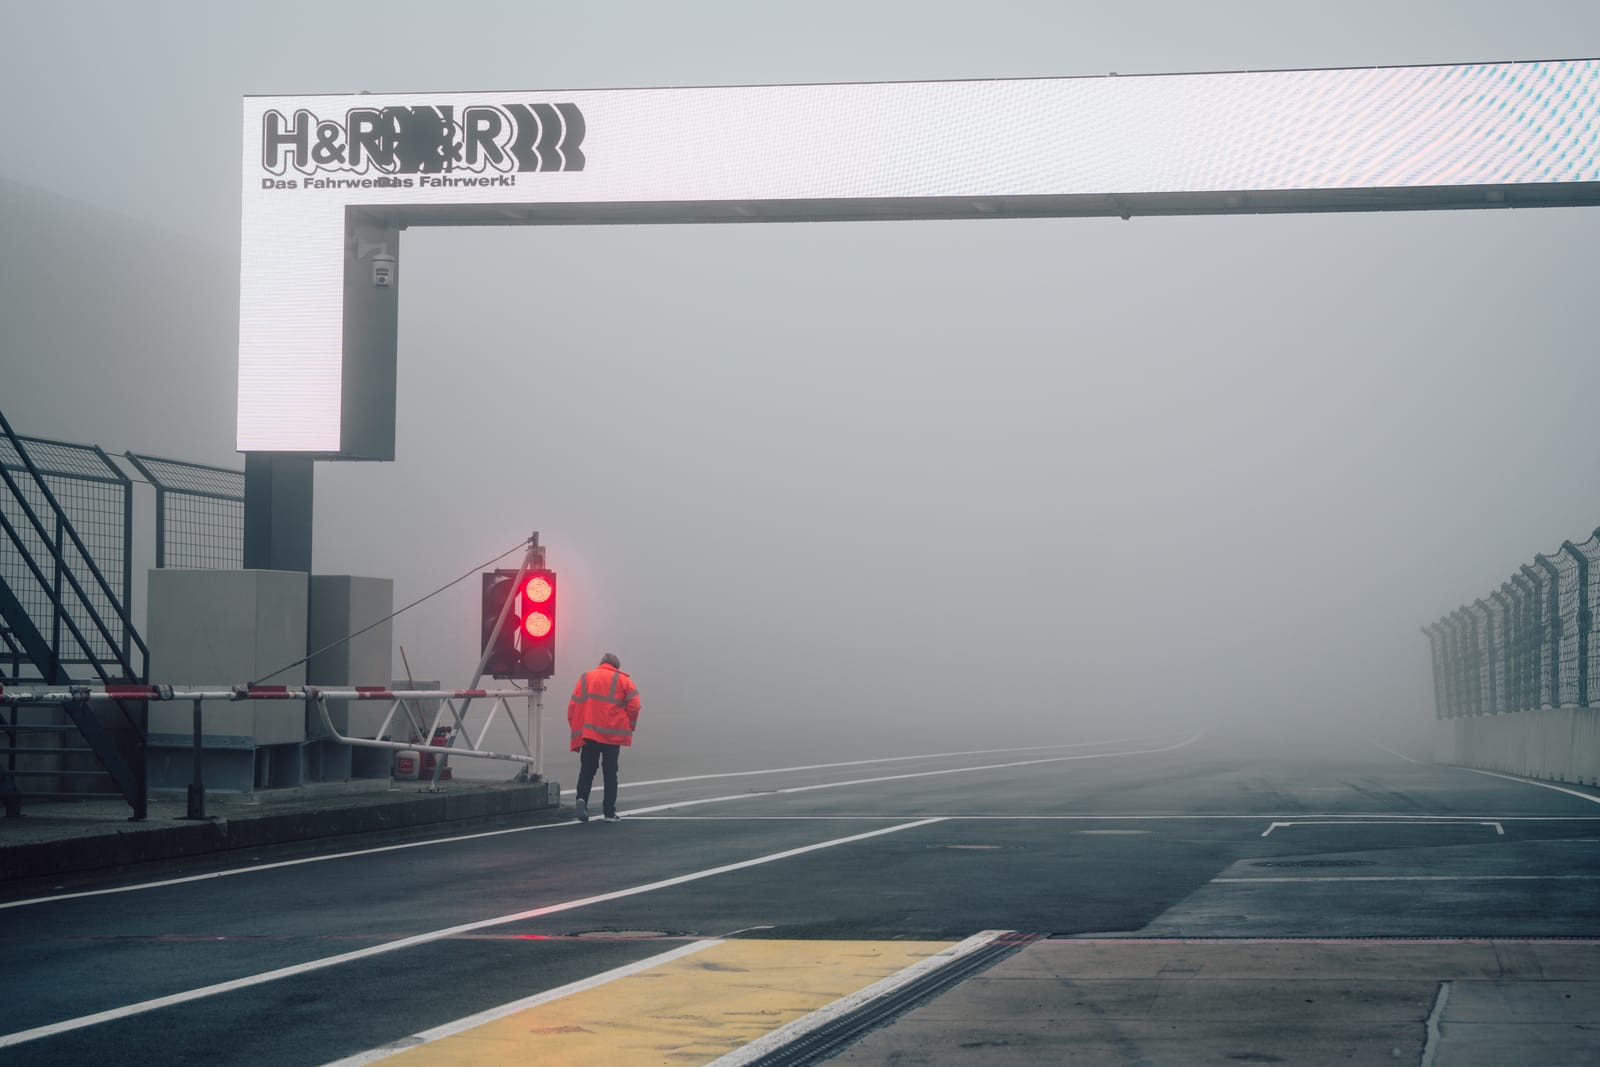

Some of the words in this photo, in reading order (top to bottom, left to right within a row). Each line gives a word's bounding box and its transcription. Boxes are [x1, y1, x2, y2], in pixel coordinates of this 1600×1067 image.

[263, 108, 399, 175] H&R
[262, 179, 297, 189] Das
[420, 174, 515, 187] Fahrwerk!
